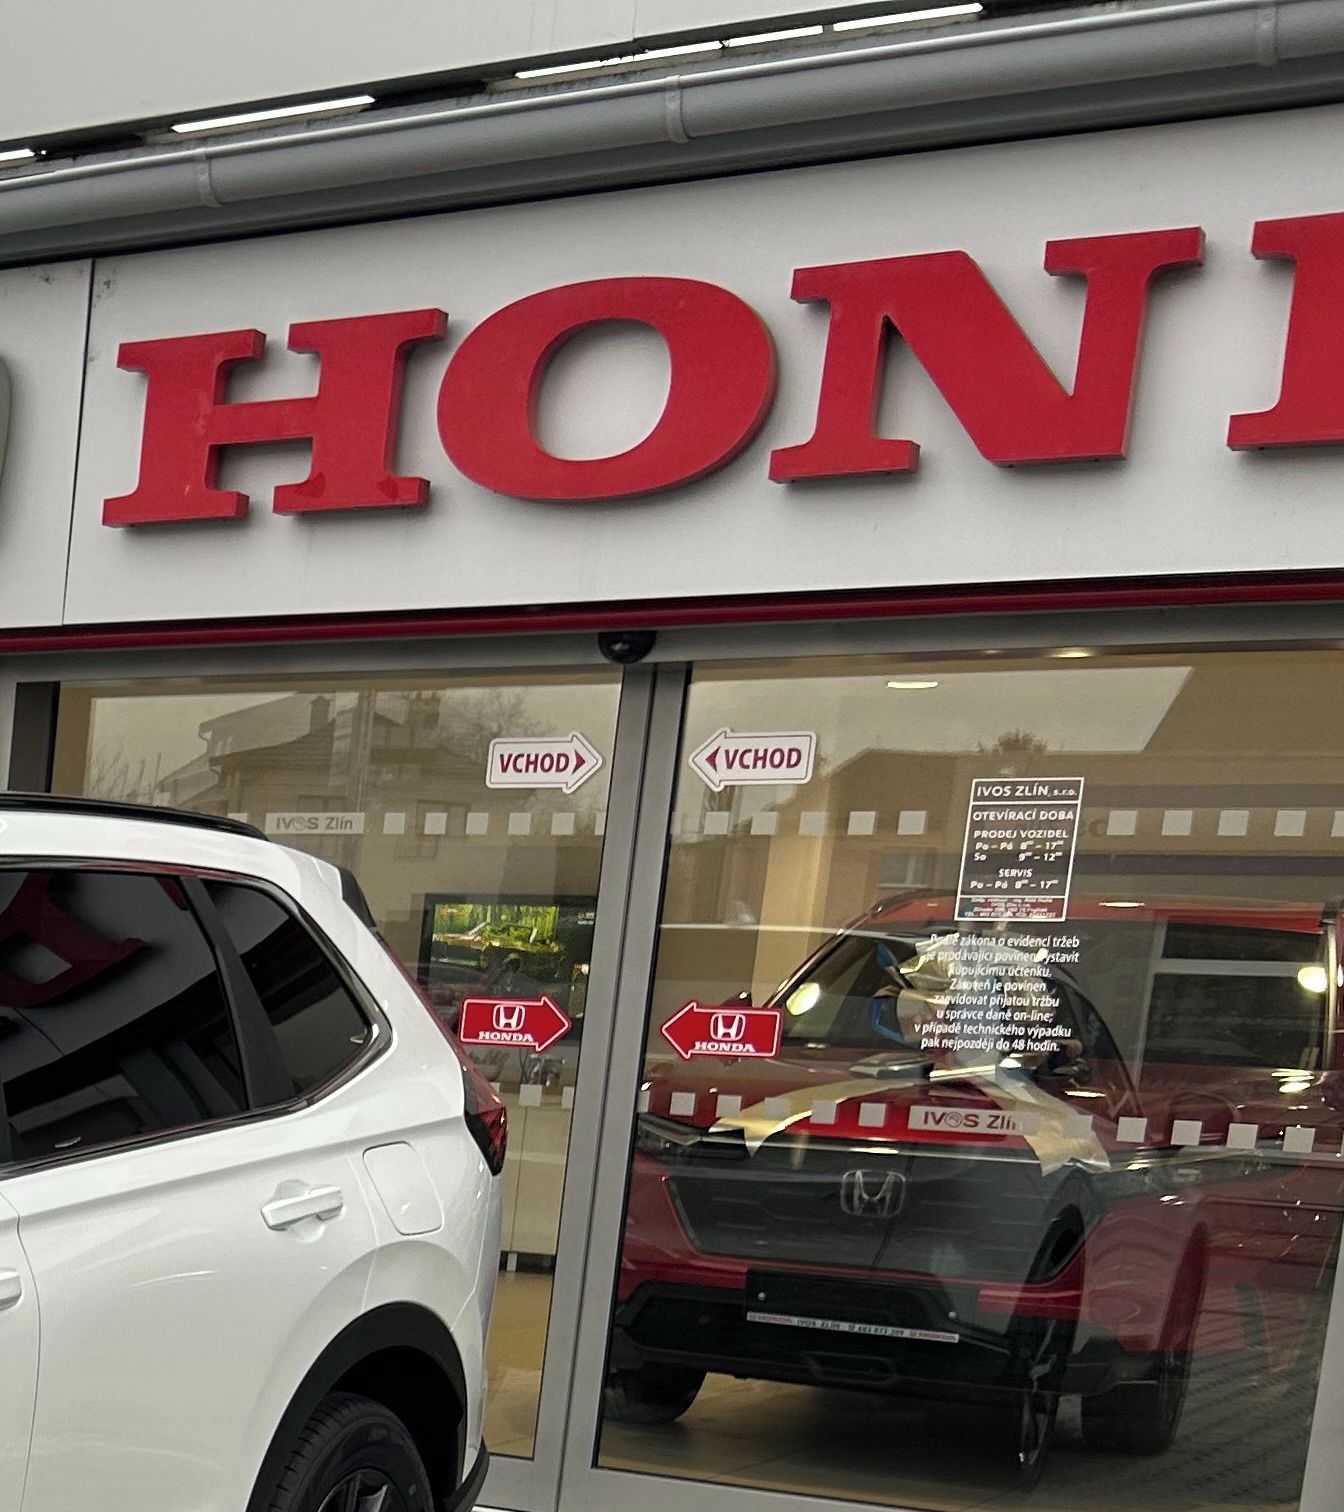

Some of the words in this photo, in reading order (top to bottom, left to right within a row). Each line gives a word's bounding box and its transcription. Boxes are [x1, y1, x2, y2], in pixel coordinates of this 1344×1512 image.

[102, 212, 1344, 527] HON
[499, 753, 570, 773] VCHOD
[724, 748, 802, 769] VCHOD
[977, 786, 1011, 797] IVOS
[973, 808, 1036, 821] OTEVÍRACÍ
[1040, 811, 1074, 820] DOBA
[325, 816, 352, 830] Zlín
[974, 830, 1017, 839] PRODEJ
[1020, 830, 1069, 839] VOZIDEL
[998, 868, 1033, 878] SERVIS
[960, 935, 996, 947] zákona
[998, 938, 1004, 947] o
[1007, 935, 1050, 948] evidencí
[1052, 935, 1080, 948] tržeb
[1037, 950, 1079, 964] ystavit
[1004, 979, 1046, 992] povinen
[989, 993, 1029, 1008] přijatou
[1032, 994, 1059, 1007] tržbu
[936, 1010, 944, 1019] u
[946, 1009, 983, 1022] správce
[986, 1009, 1011, 1020] daně
[478, 1031, 534, 1042] HONDA
[922, 1022, 961, 1037] případě
[962, 1023, 1025, 1036] technického
[1027, 1024, 1071, 1039] výpadku
[694, 1041, 756, 1052] HONDA
[921, 1037, 939, 1051] pak
[942, 1038, 994, 1052] nejpozději
[996, 1038, 1010, 1050] do
[1012, 1039, 1026, 1050] 48
[1027, 1039, 1060, 1052] hodin.
